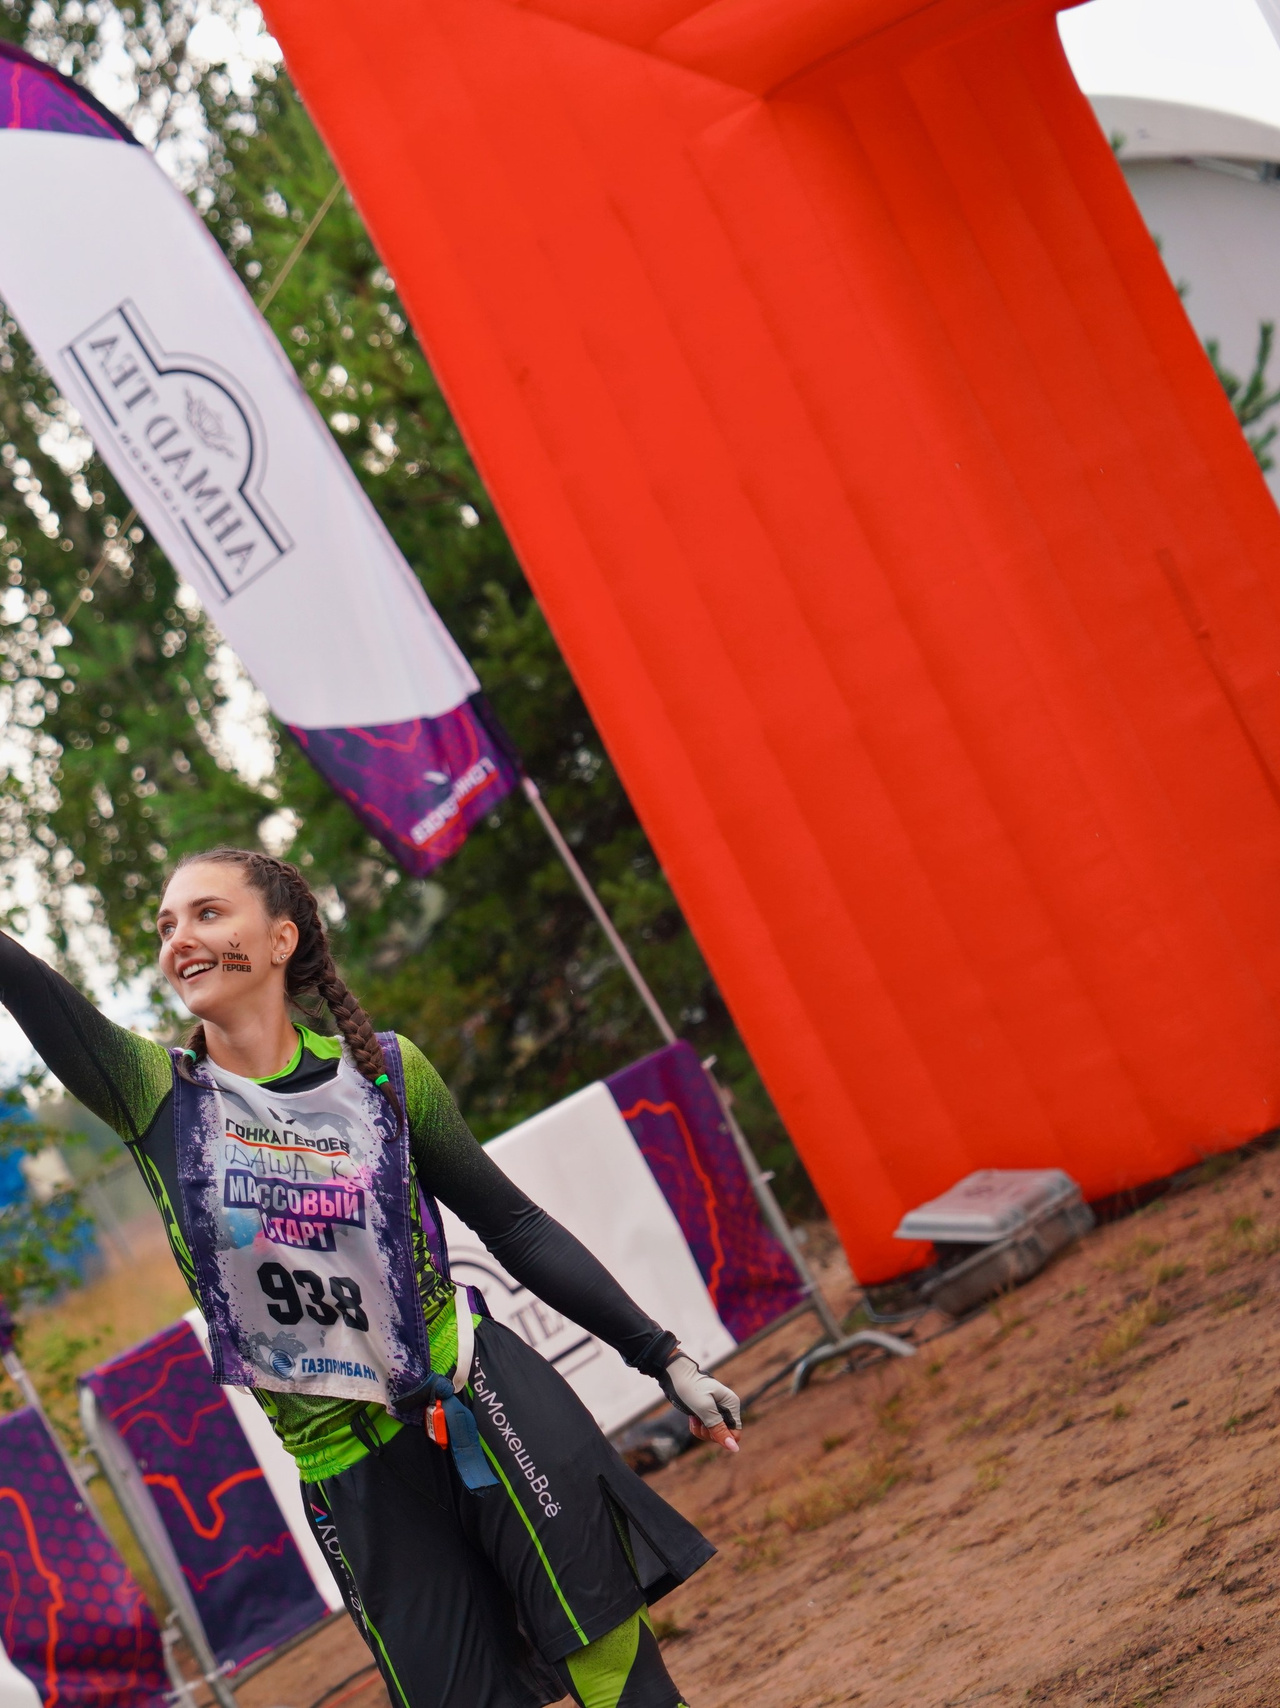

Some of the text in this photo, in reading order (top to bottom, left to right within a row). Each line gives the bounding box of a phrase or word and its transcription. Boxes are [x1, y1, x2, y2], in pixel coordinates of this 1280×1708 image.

[222, 952, 250, 962] ГОНКА
[222, 963, 252, 973] ГЕРОЕВ
[225, 1117, 351, 1155] ГОНКА ГЕРОЕВ
[225, 1144, 313, 1181] ДАША
[228, 1174, 361, 1223] МАССОВЫЙ
[261, 1211, 328, 1249] СТАРТ
[256, 1261, 370, 1333] 938
[508, 1297, 566, 1348] TE
[301, 1357, 380, 1384] ГАЗПРОМБАНК
